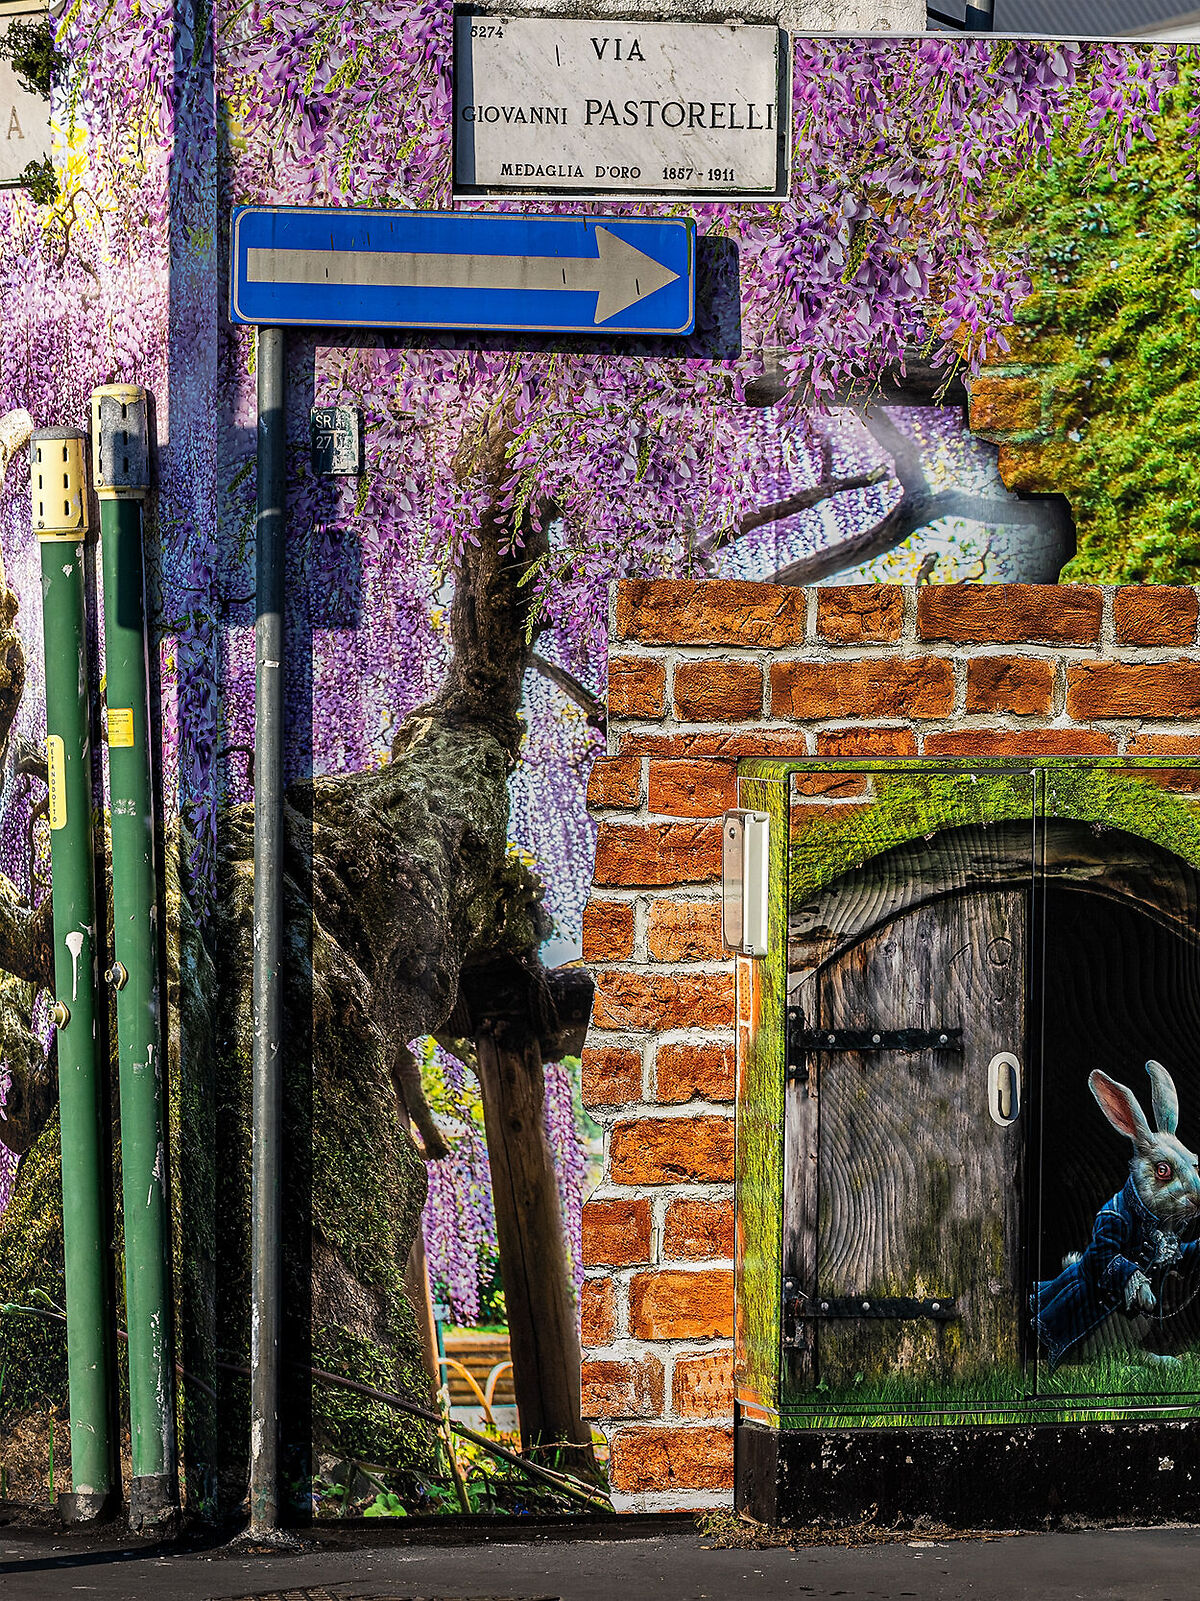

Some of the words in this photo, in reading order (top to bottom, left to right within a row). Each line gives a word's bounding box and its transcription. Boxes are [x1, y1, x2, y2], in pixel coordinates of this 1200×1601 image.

[590, 37, 646, 61] VIA
[7, 105, 25, 140] A
[461, 105, 568, 125] GIOVANNI
[584, 99, 775, 130] PASTORELLI
[500, 163, 584, 178] MEDAGLIA
[595, 165, 641, 179] D'ORO
